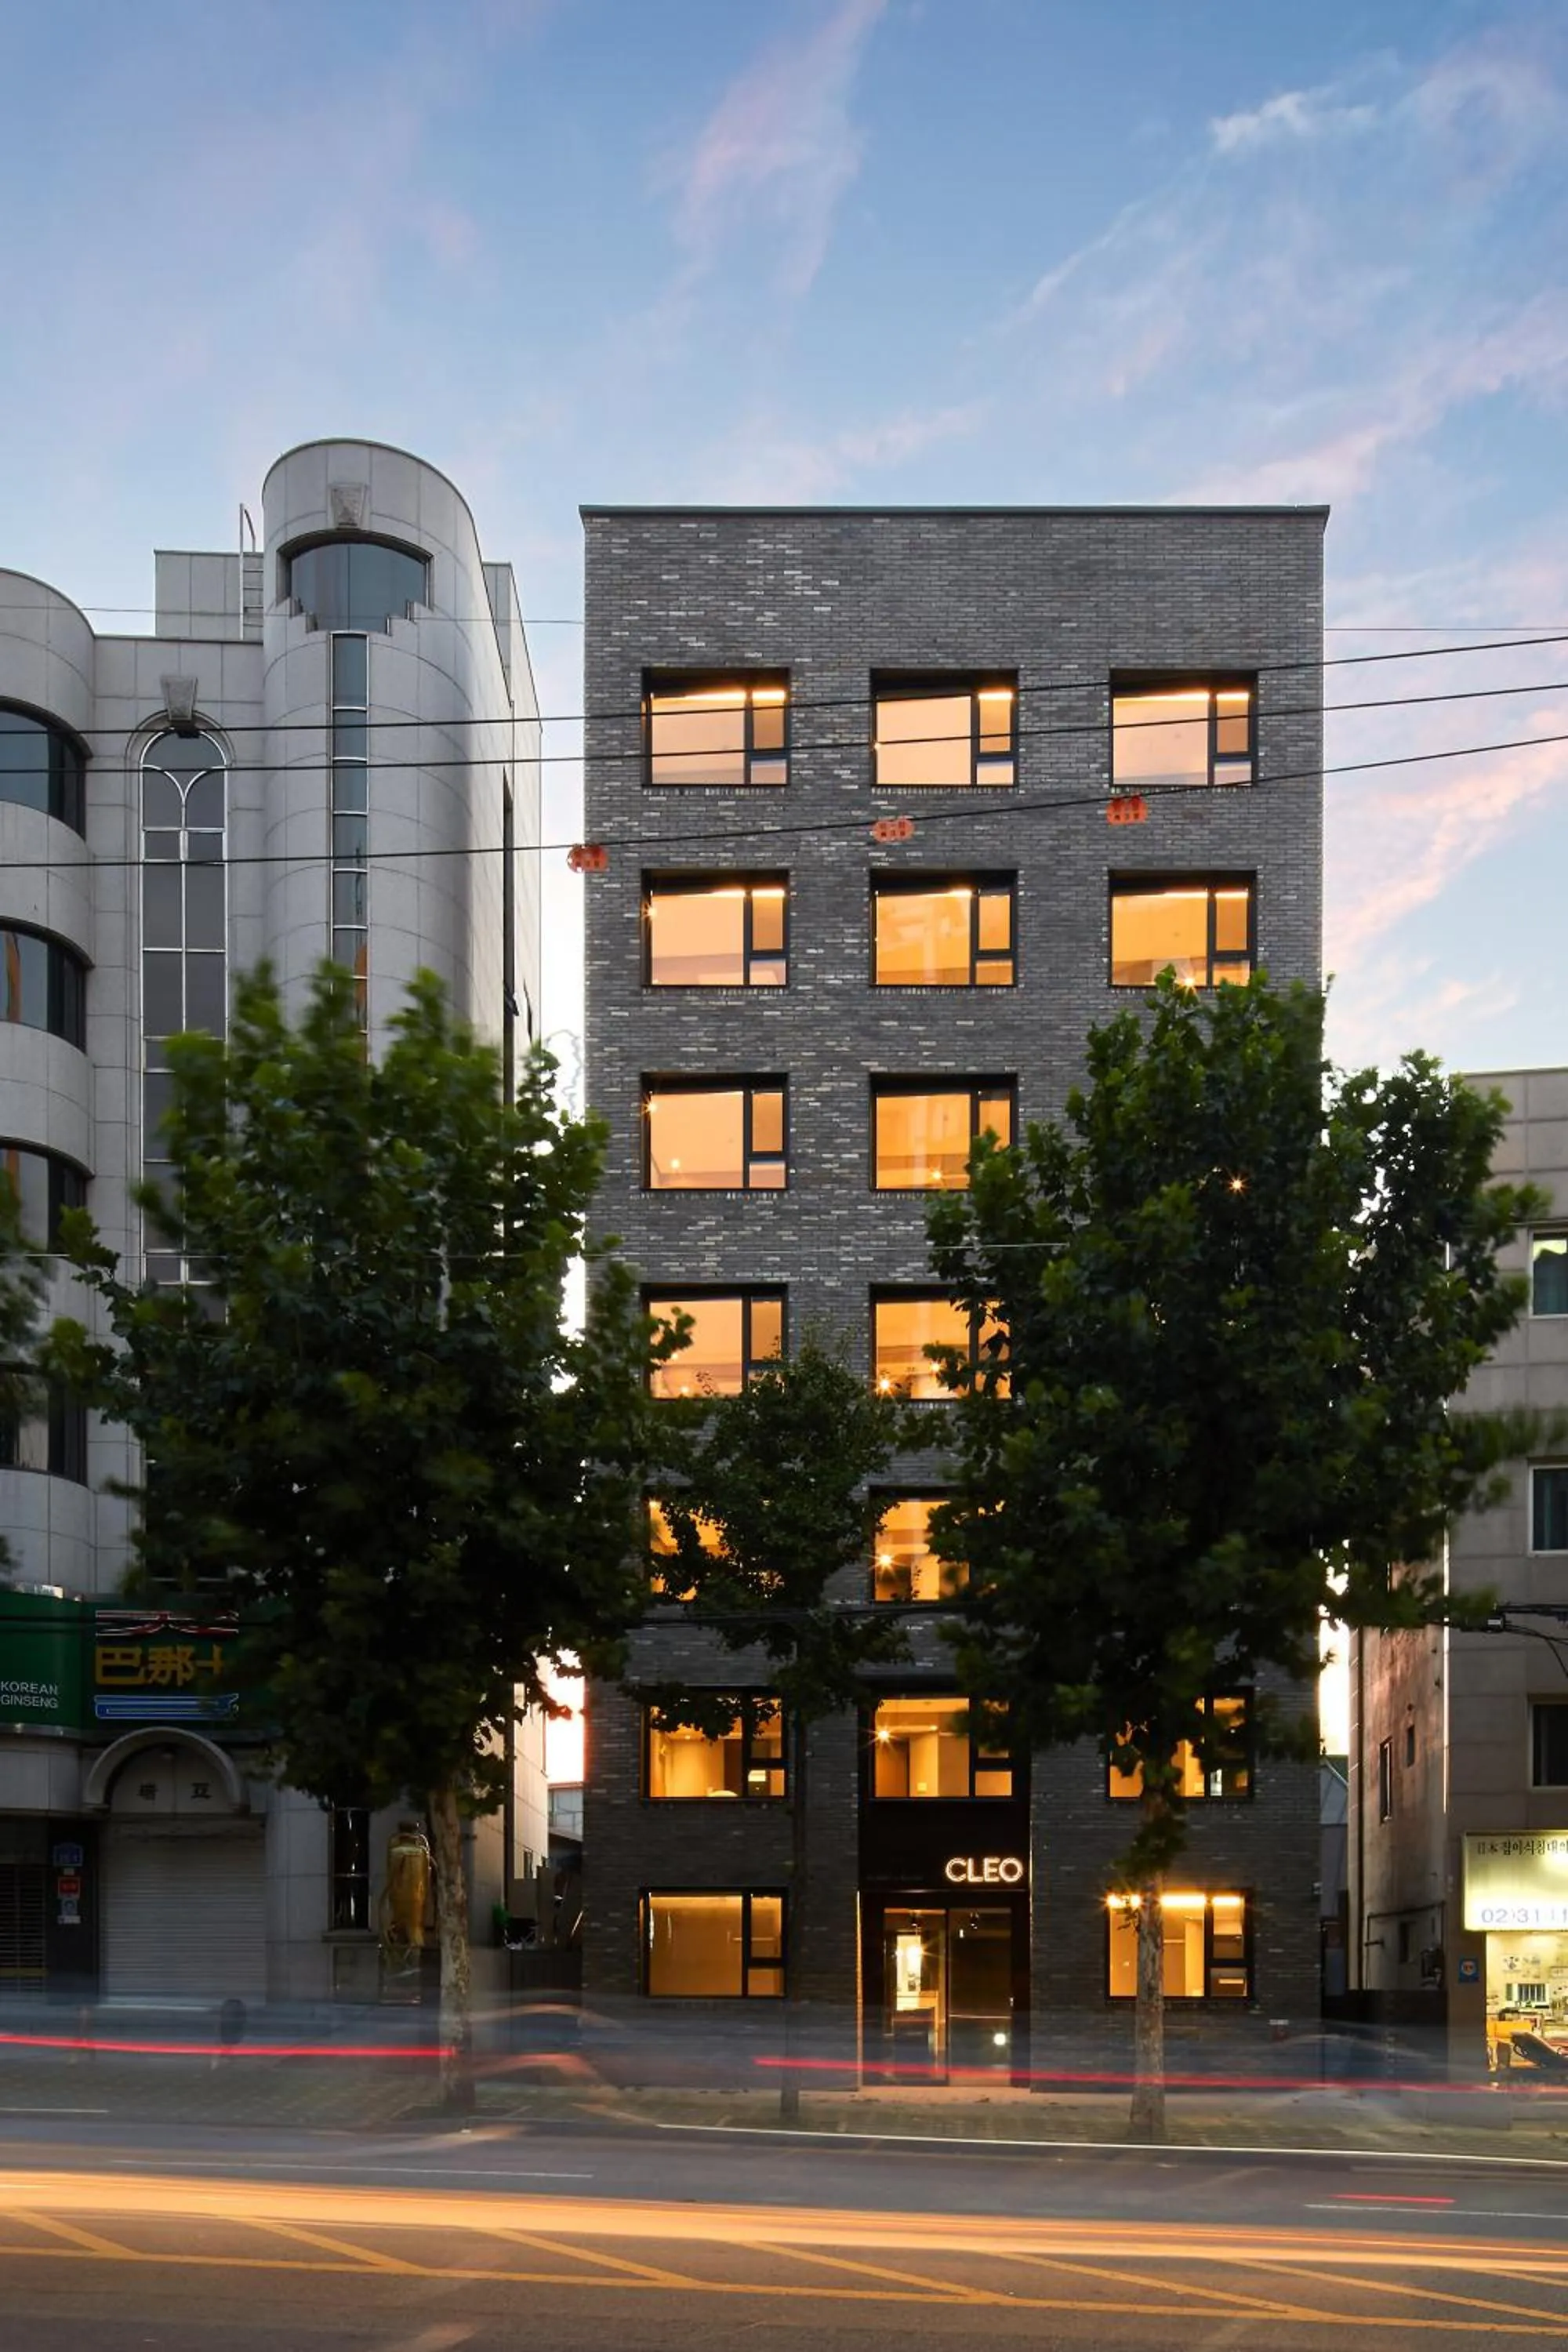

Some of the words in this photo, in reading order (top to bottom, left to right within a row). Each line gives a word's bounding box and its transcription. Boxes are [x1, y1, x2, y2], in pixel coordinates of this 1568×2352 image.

[1, 1681, 58, 1695] KOREAN
[1, 1694, 59, 1708] GINSENG
[946, 1857, 1023, 1882] CLEO
